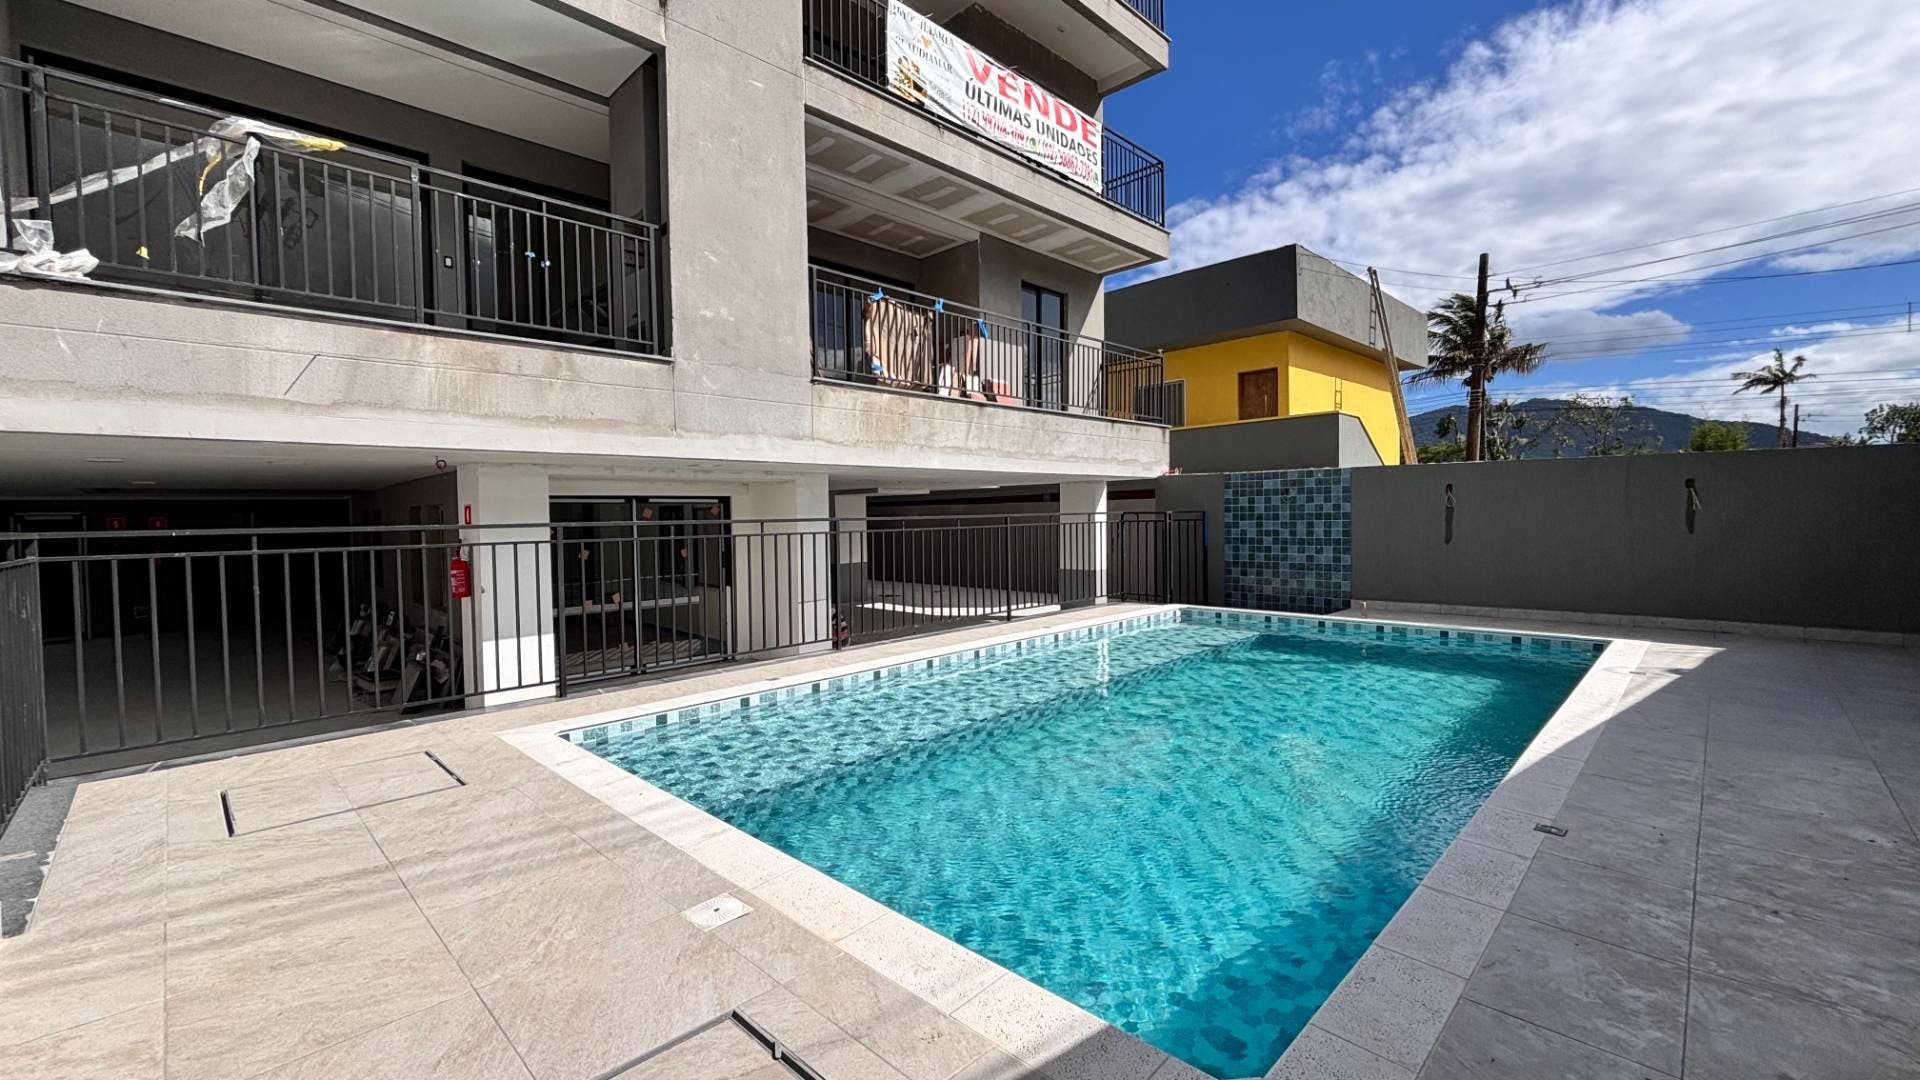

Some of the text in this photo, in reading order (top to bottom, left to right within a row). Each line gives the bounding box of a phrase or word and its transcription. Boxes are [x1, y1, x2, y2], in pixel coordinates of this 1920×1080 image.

[964, 48, 1098, 149] VENDE
[965, 77, 1031, 129] ÚLTIMAS
[1036, 118, 1098, 166] UNIDADES
